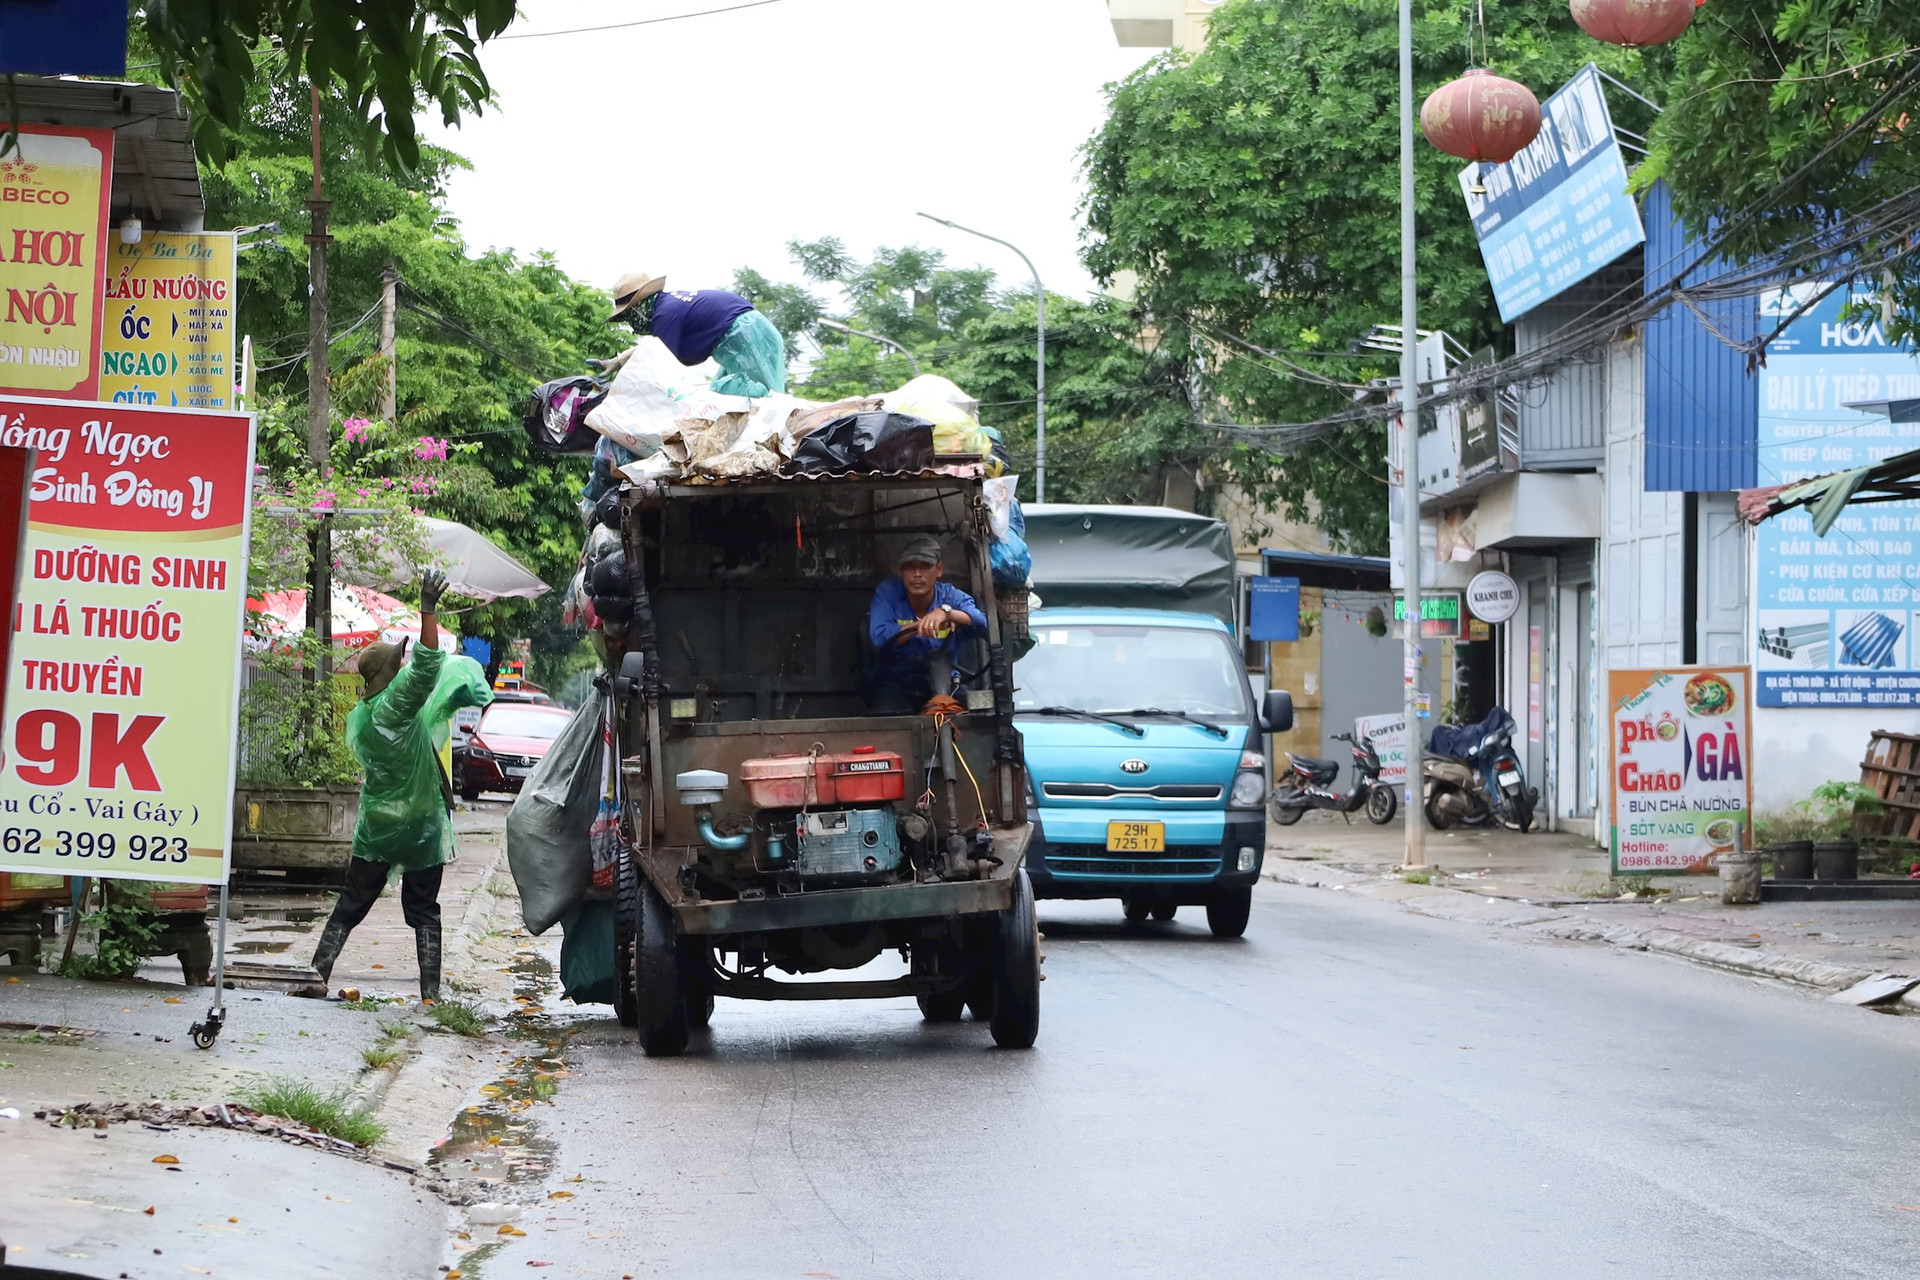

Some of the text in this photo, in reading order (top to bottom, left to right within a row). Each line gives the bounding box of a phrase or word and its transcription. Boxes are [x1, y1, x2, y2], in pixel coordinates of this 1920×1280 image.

[0, 187, 70, 205] BECO
[11, 229, 85, 266] HƠI
[105, 265, 227, 301] LẨU NƯỚNG
[5, 282, 79, 335] NỘI
[120, 305, 151, 340] ỐC
[104, 351, 167, 376] NGAO
[209, 366, 224, 375] ME
[209, 398, 224, 407] ME
[81, 420, 171, 466] Ngọc
[1781, 444, 1817, 461] THÉP
[1822, 442, 1853, 461] ỐNG
[29, 467, 214, 520] Sinh Đông Y
[1871, 513, 1901, 532] TÔN
[1884, 541, 1912, 555] B40
[34, 545, 227, 590] DƯỠNG SINH
[1779, 564, 1809, 583] PHỤ
[1813, 562, 1848, 582] KIỆN
[1474, 591, 1499, 602] KHANH
[33, 598, 70, 635] LÁ
[81, 600, 182, 641] THUỐC
[23, 655, 142, 696] TRUYỀN
[1696, 721, 1744, 782] GÀ
[850, 761, 891, 772] CHANGTIANFA
[1124, 761, 1146, 772] KIA
[28, 791, 64, 815] Cổ
[85, 798, 124, 819] Vai
[133, 801, 183, 827] Gáy
[1629, 795, 1656, 813] BÚN
[1123, 824, 1149, 836] 29H
[1658, 822, 1695, 835] VANG
[55, 830, 116, 859] 399
[129, 835, 188, 863] 923
[1113, 838, 1159, 850] 725.17
[1621, 841, 1668, 853] Hotline:
